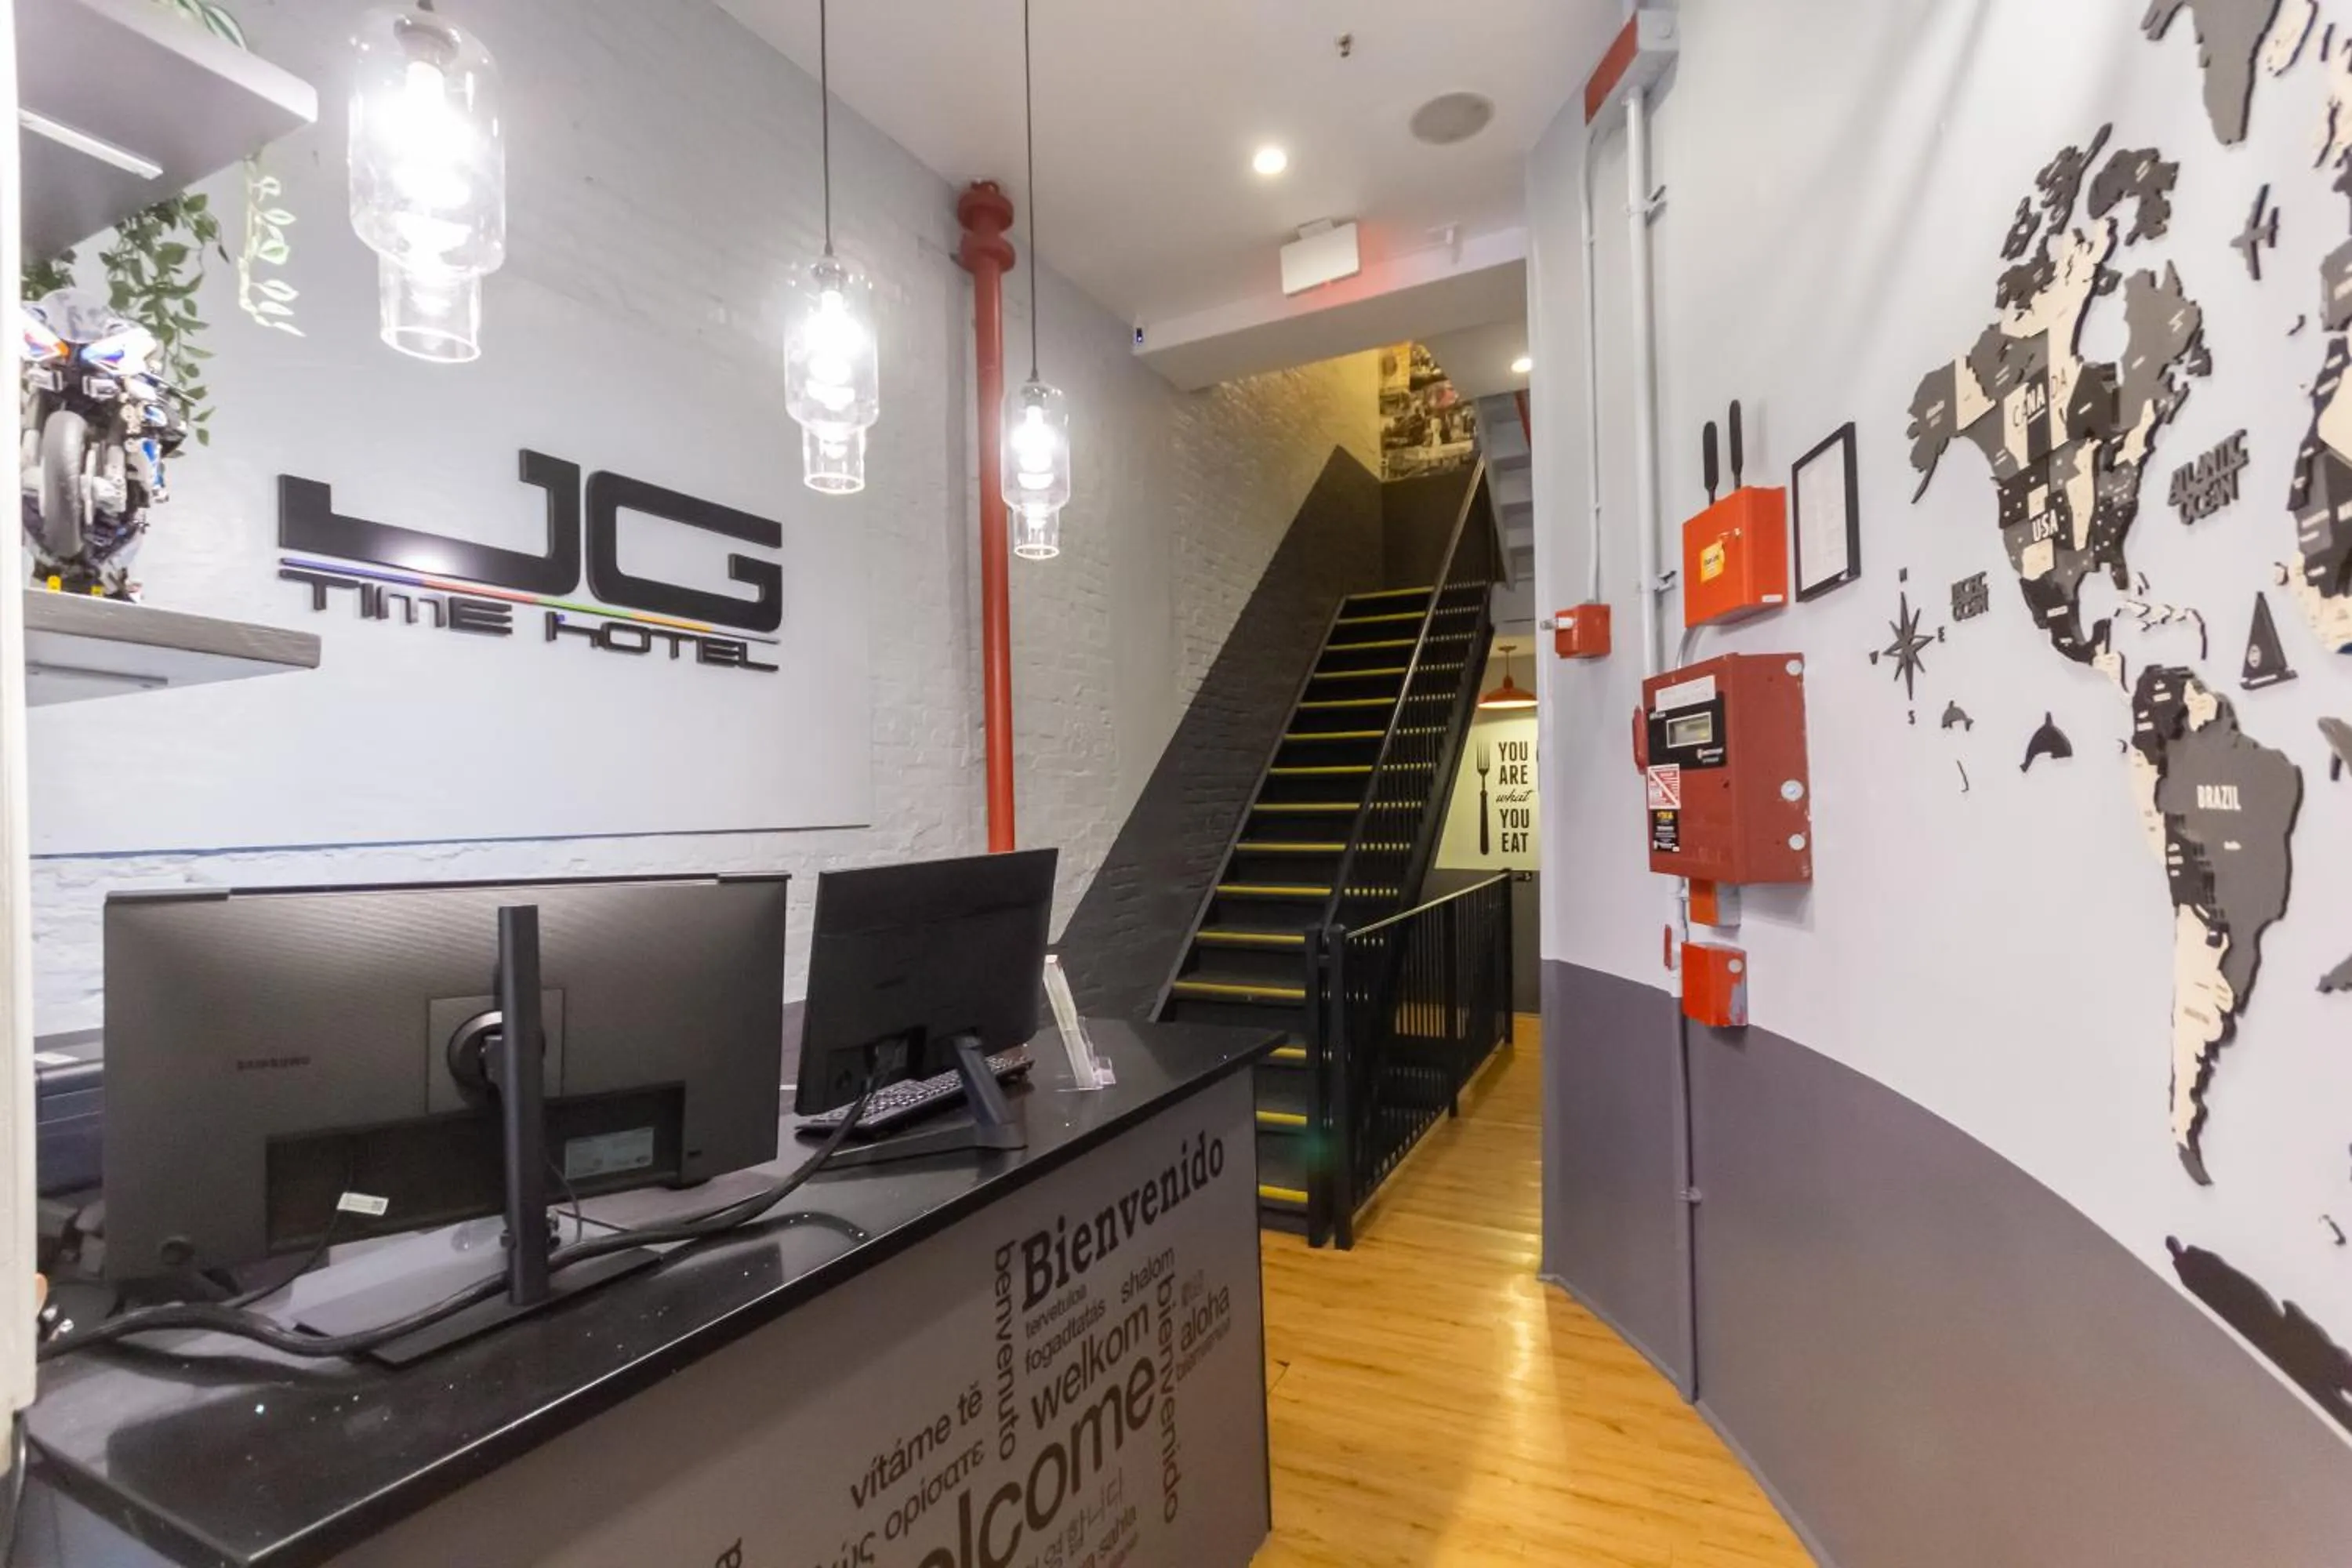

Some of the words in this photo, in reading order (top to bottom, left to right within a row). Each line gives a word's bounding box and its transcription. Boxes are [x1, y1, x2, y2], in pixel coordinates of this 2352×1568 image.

[2180, 468, 2239, 525] OCEAN
[2032, 509, 2060, 542] USA
[278, 568, 513, 636] TIME
[545, 612, 779, 672] HOTEL
[1498, 741, 1528, 762] YOU
[1499, 764, 1528, 785] ARE
[1495, 789, 1534, 803] what
[1499, 808, 1530, 829] YOU
[2197, 785, 2241, 811] BRAZIL
[1501, 832, 1529, 853] EAT
[1021, 1129, 1224, 1312] Bienvenido
[1120, 1247, 1175, 1304] shalom
[1181, 1283, 1230, 1352] aloha
[994, 1239, 1019, 1462] benvenuto
[1031, 1301, 1149, 1431] welkom
[1156, 1272, 1181, 1524] bienvenido
[917, 1356, 1156, 1568] lcome
